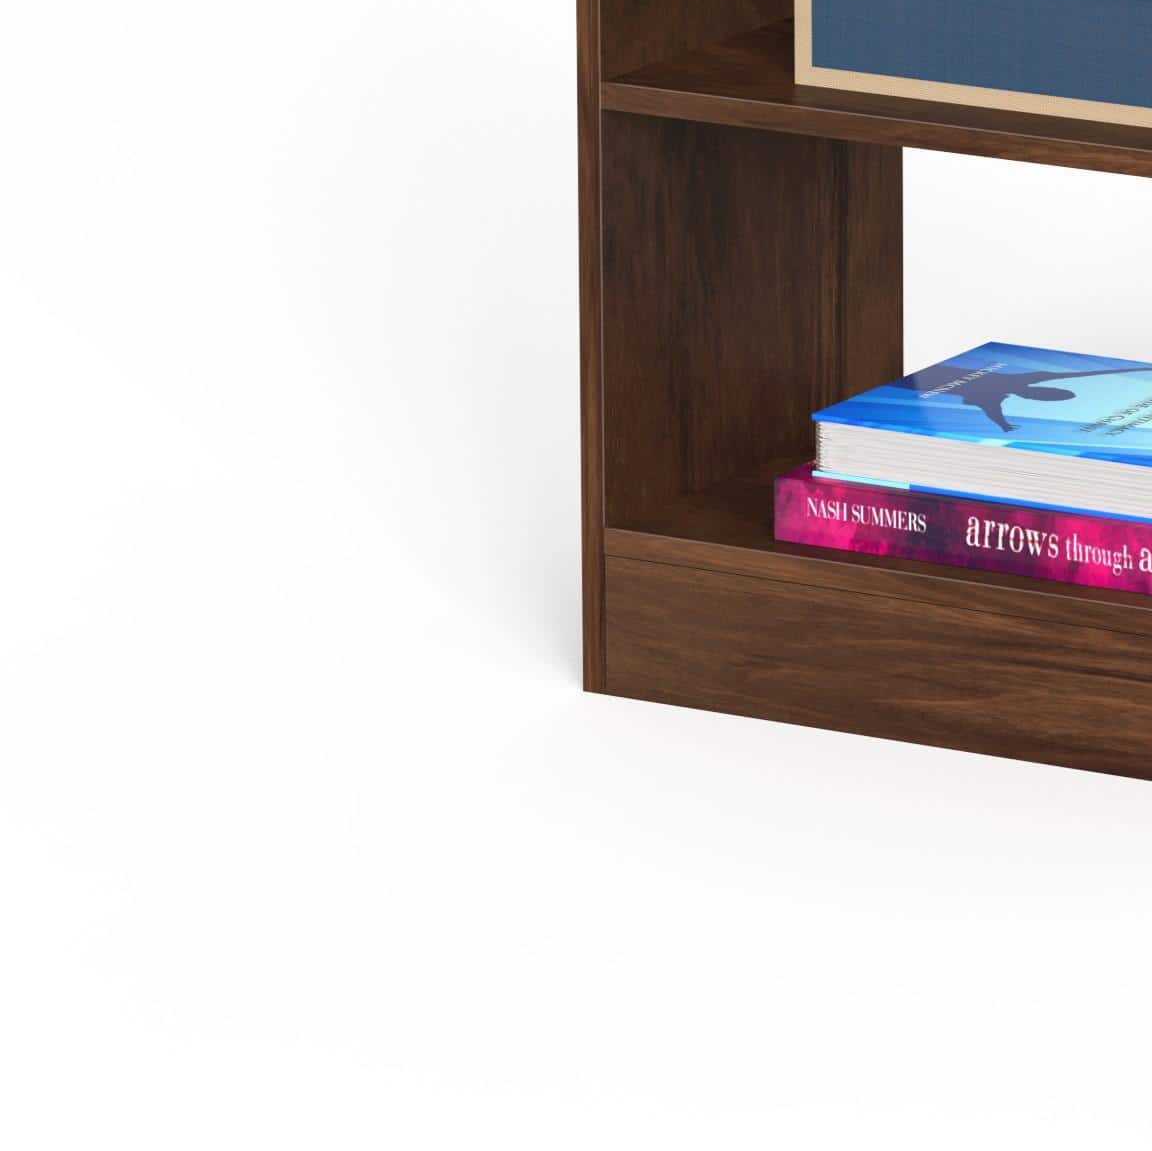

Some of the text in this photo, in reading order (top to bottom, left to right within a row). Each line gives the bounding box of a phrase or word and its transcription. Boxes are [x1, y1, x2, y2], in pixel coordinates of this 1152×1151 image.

[851, 503, 927, 533] SUMMERS
[965, 515, 1059, 559] arrows
[1065, 533, 1133, 576] through
